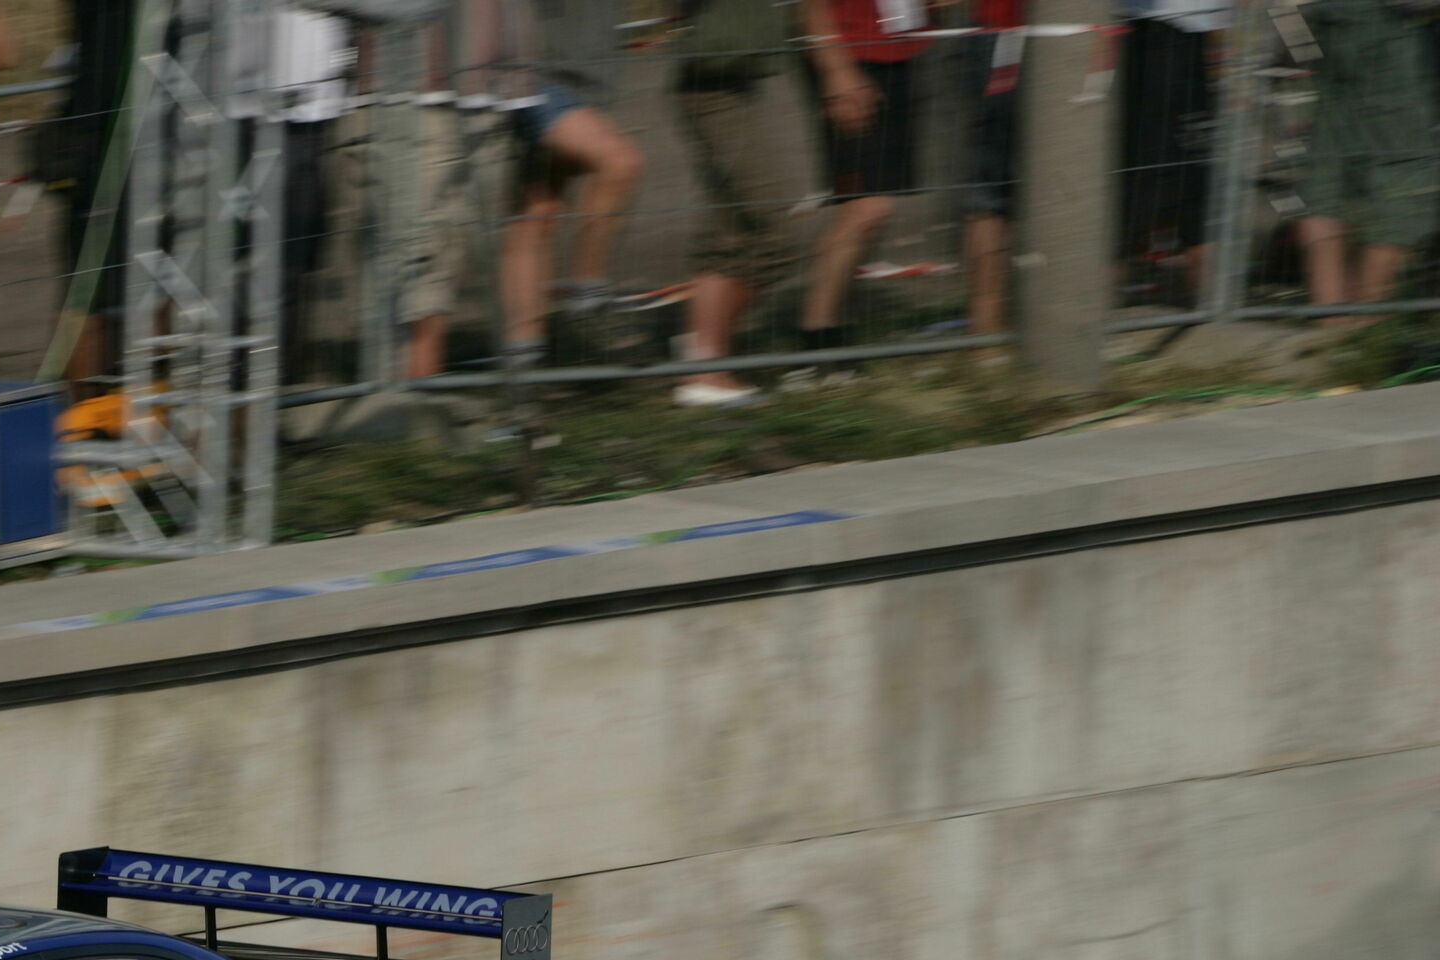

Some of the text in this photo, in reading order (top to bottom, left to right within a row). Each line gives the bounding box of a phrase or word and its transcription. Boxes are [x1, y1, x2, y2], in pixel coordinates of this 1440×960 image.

[117, 860, 503, 926] GIVES YOU WING
